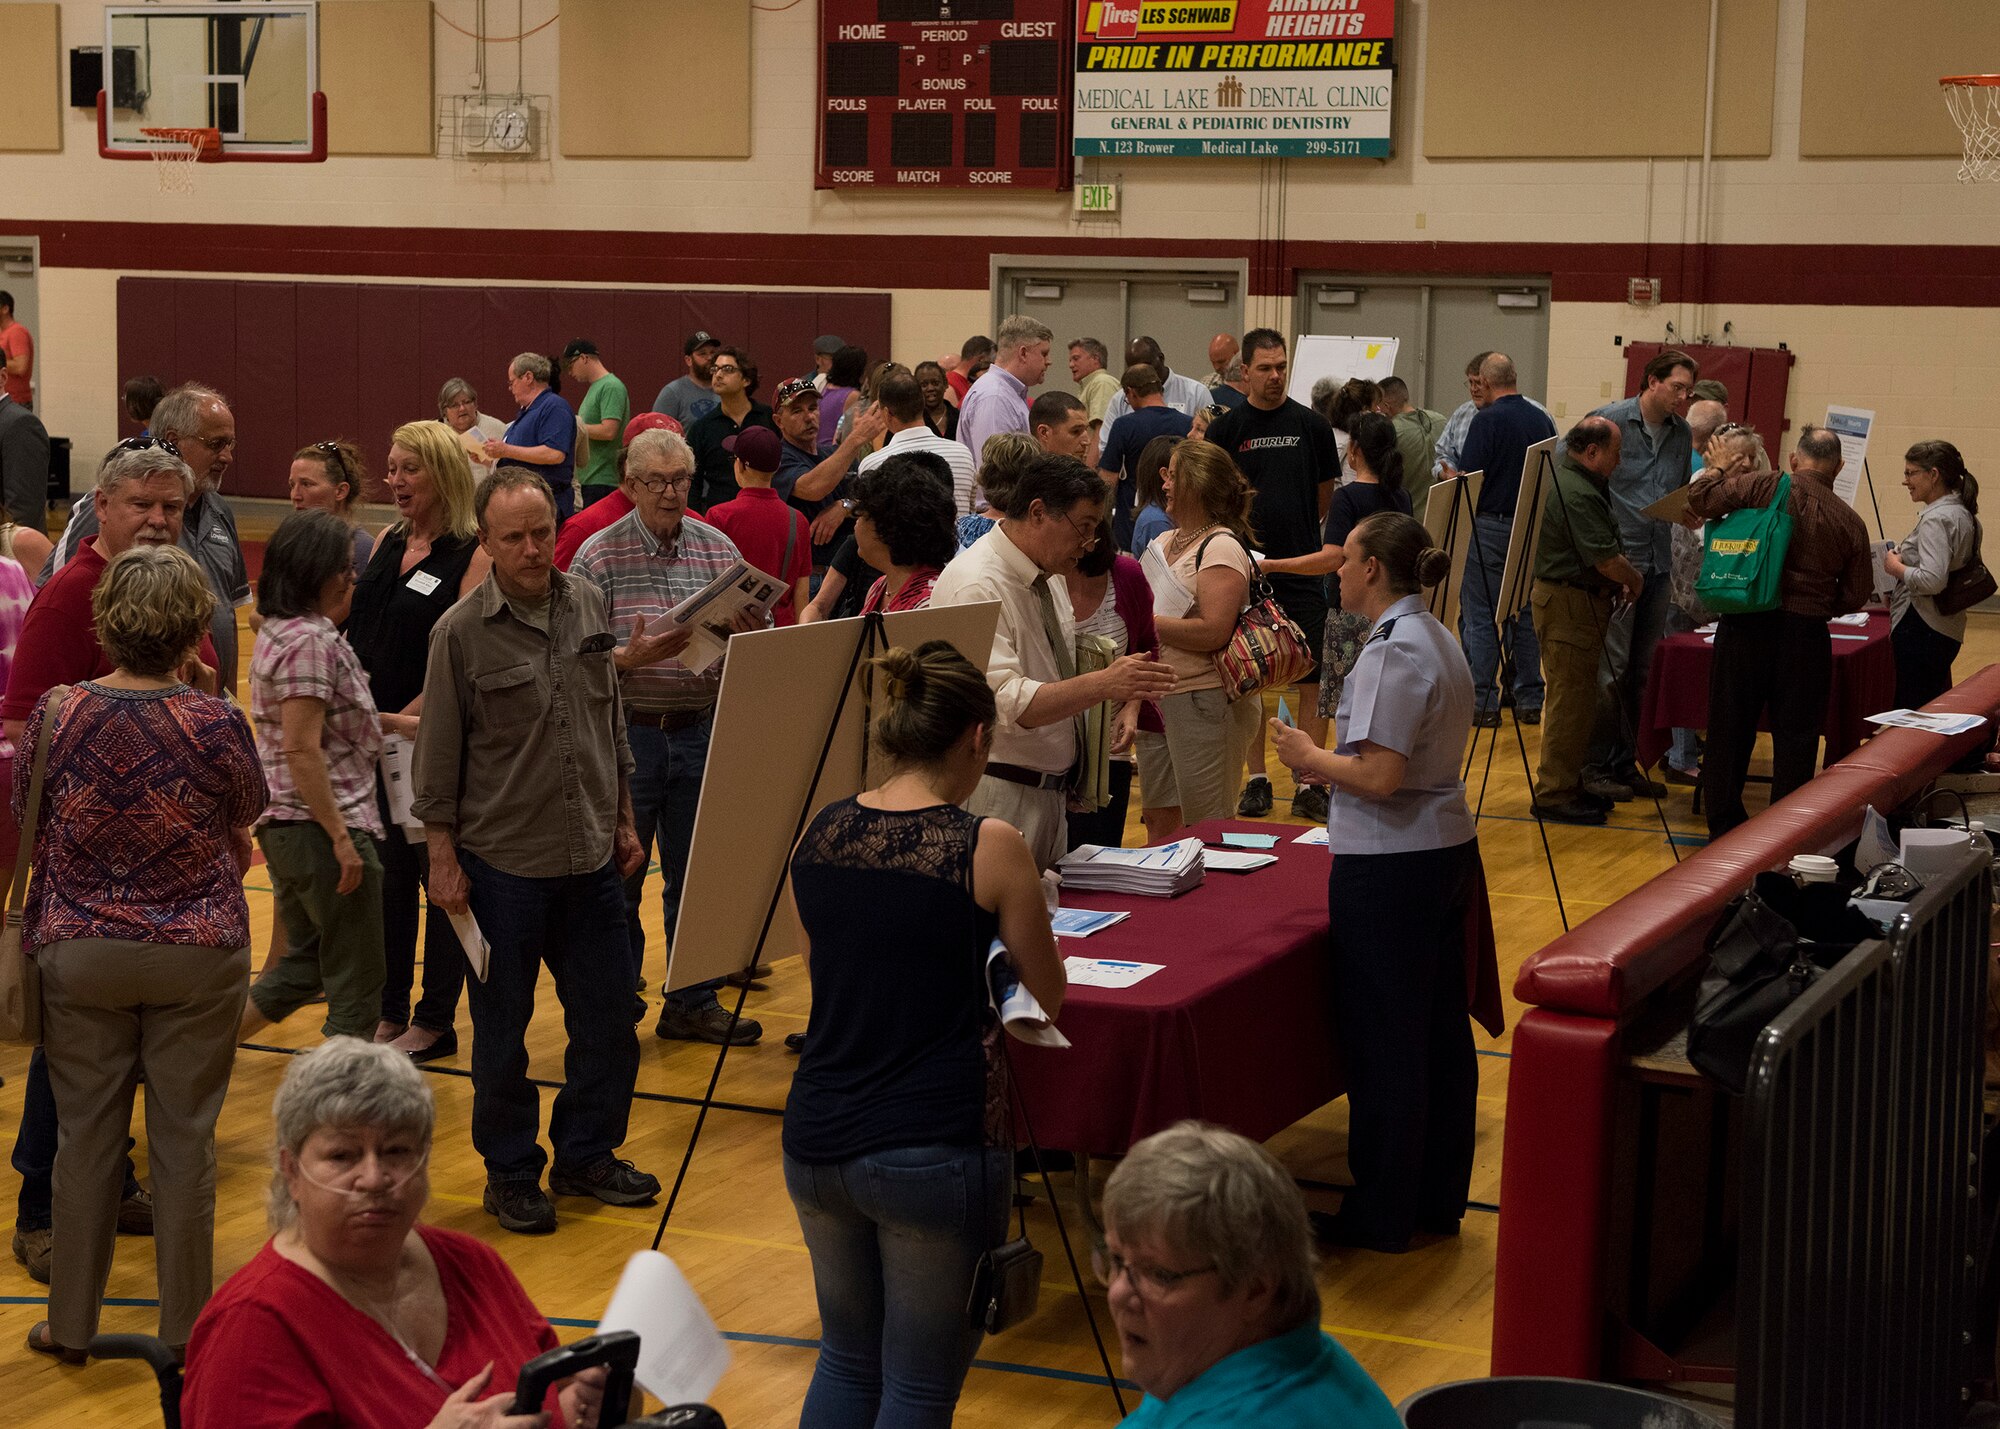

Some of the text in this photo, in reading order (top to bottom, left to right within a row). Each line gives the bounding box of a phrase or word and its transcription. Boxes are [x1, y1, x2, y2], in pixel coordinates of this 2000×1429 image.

[1103, 2, 1139, 27] Tires
[1142, 7, 1231, 24] LES SCHWAB
[1000, 21, 1056, 38] GUEST
[1265, 13, 1365, 37] HEIGHTS
[838, 24, 886, 40] HOME
[921, 30, 968, 42] PERIOD
[916, 54, 926, 66] P
[963, 54, 972, 66] P
[1086, 41, 1385, 69] PRIDE IN PERFORMANCE
[922, 78, 967, 90] BONUS
[1077, 85, 1389, 110] MEDICAL LAKE DENTAL CLINIC
[828, 99, 867, 111] FOULS
[898, 99, 947, 111] PLAYER
[963, 98, 996, 111] FOUL
[1111, 116, 1351, 130] GENERAL & PEDIATRIC DENTISTRY
[1099, 141, 1361, 154] N. 123 Brower Medical Lake 299-5171
[832, 170, 874, 183] SCORE
[897, 170, 940, 183] MATCH
[969, 171, 1012, 184] SCORE
[1082, 185, 1109, 208] EXIT
[1250, 436, 1300, 449] HURLEY
